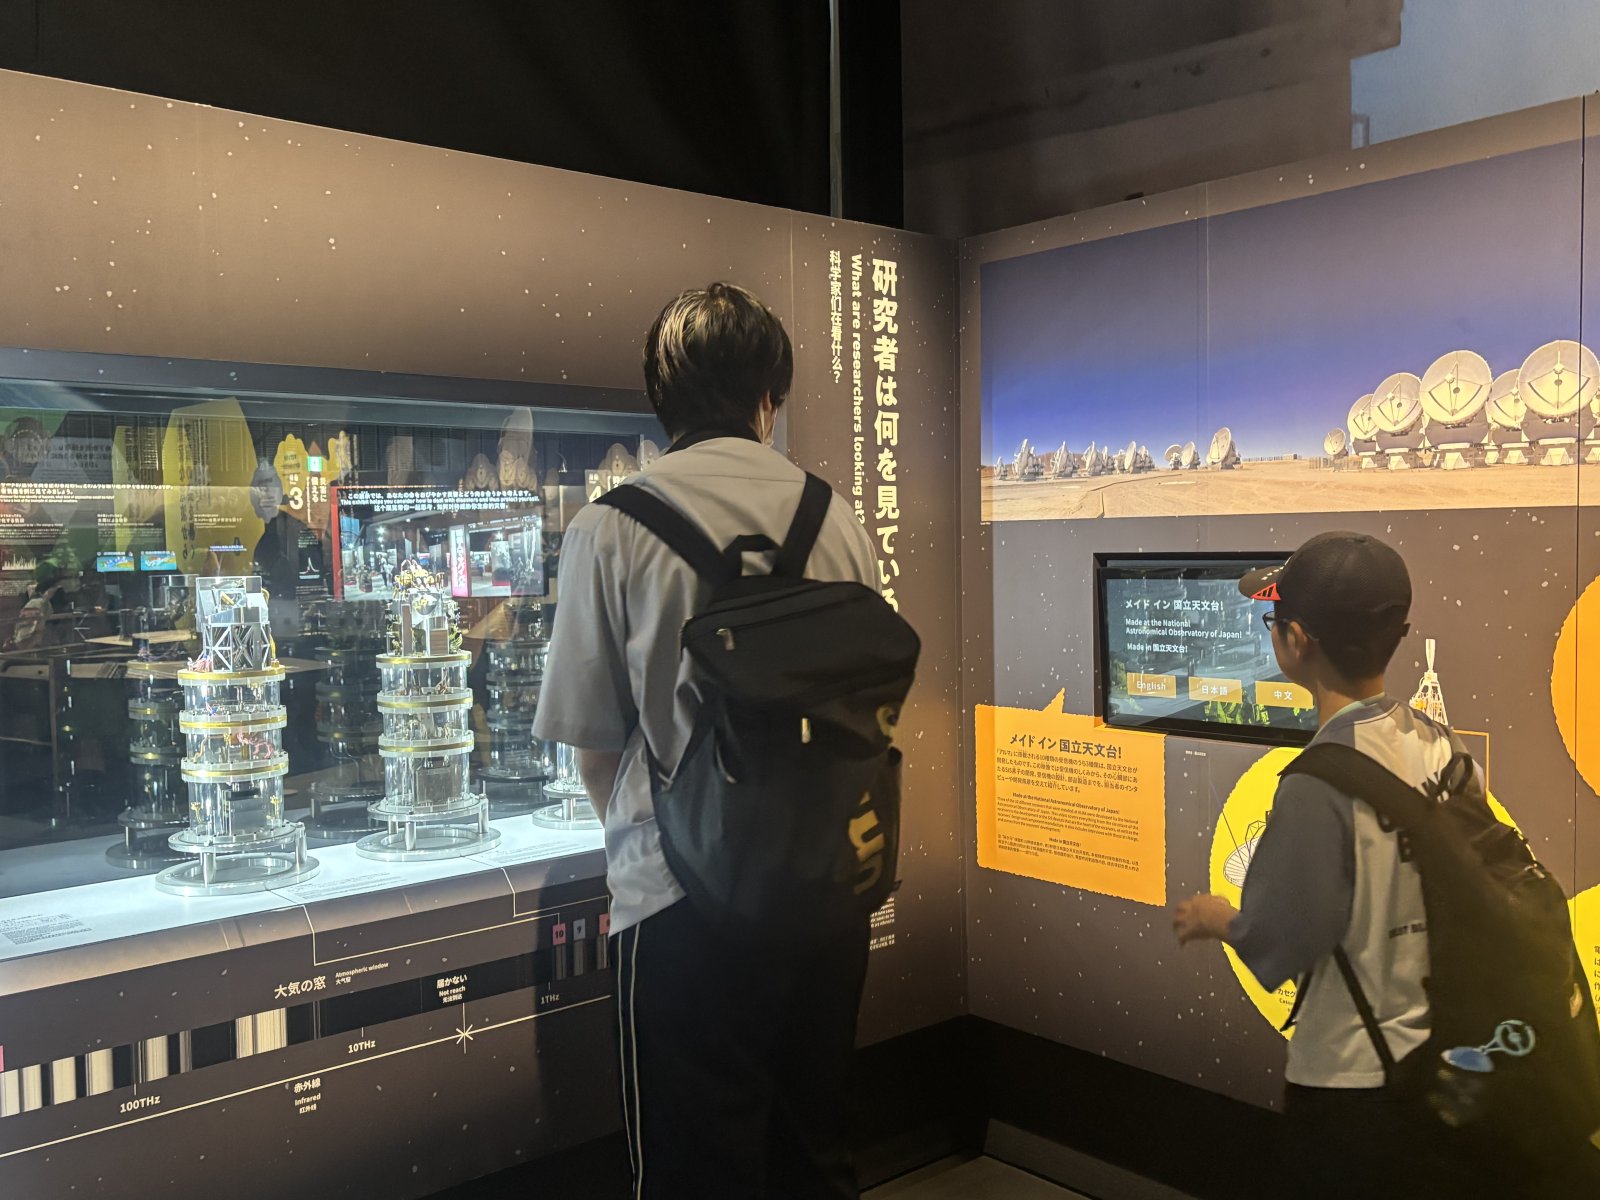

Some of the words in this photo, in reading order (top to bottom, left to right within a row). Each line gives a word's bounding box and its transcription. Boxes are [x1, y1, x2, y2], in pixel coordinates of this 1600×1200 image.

[851, 253, 863, 298] What
[852, 301, 862, 330] are
[852, 332, 865, 434] researchers
[852, 436, 865, 497] looking
[289, 486, 304, 510] 3
[1125, 599, 1150, 610] メイド
[1153, 599, 1171, 610] イン
[1173, 599, 1224, 612] 国立天文台!
[1125, 618, 1143, 626] Made
[1143, 618, 1150, 626] at
[1151, 618, 1161, 627] the
[1162, 618, 1191, 628] National
[1125, 627, 1168, 636] Astronomical
[1168, 628, 1209, 639] Observatory
[1210, 629, 1217, 638] of
[1218, 630, 1242, 640] Japan!
[1127, 643, 1144, 651] Made
[1145, 643, 1152, 651] in
[1136, 680, 1166, 691] English
[1201, 684, 1228, 696] 日本語
[1273, 690, 1293, 701] 中文
[1010, 733, 1035, 748] メイド
[1038, 736, 1057, 750] イン
[1059, 738, 1122, 759] 国立天文台!
[335, 965, 368, 978] Atmospheric
[368, 962, 389, 972] window
[274, 975, 327, 999] 大気の窓
[439, 989, 450, 998] Not
[450, 985, 466, 995] reach
[540, 994, 560, 1005] 1THz
[348, 1040, 376, 1054] 10THz
[294, 1077, 321, 1093] 赤外線
[120, 1095, 161, 1113] 100THz
[294, 1093, 321, 1106] Infrared
